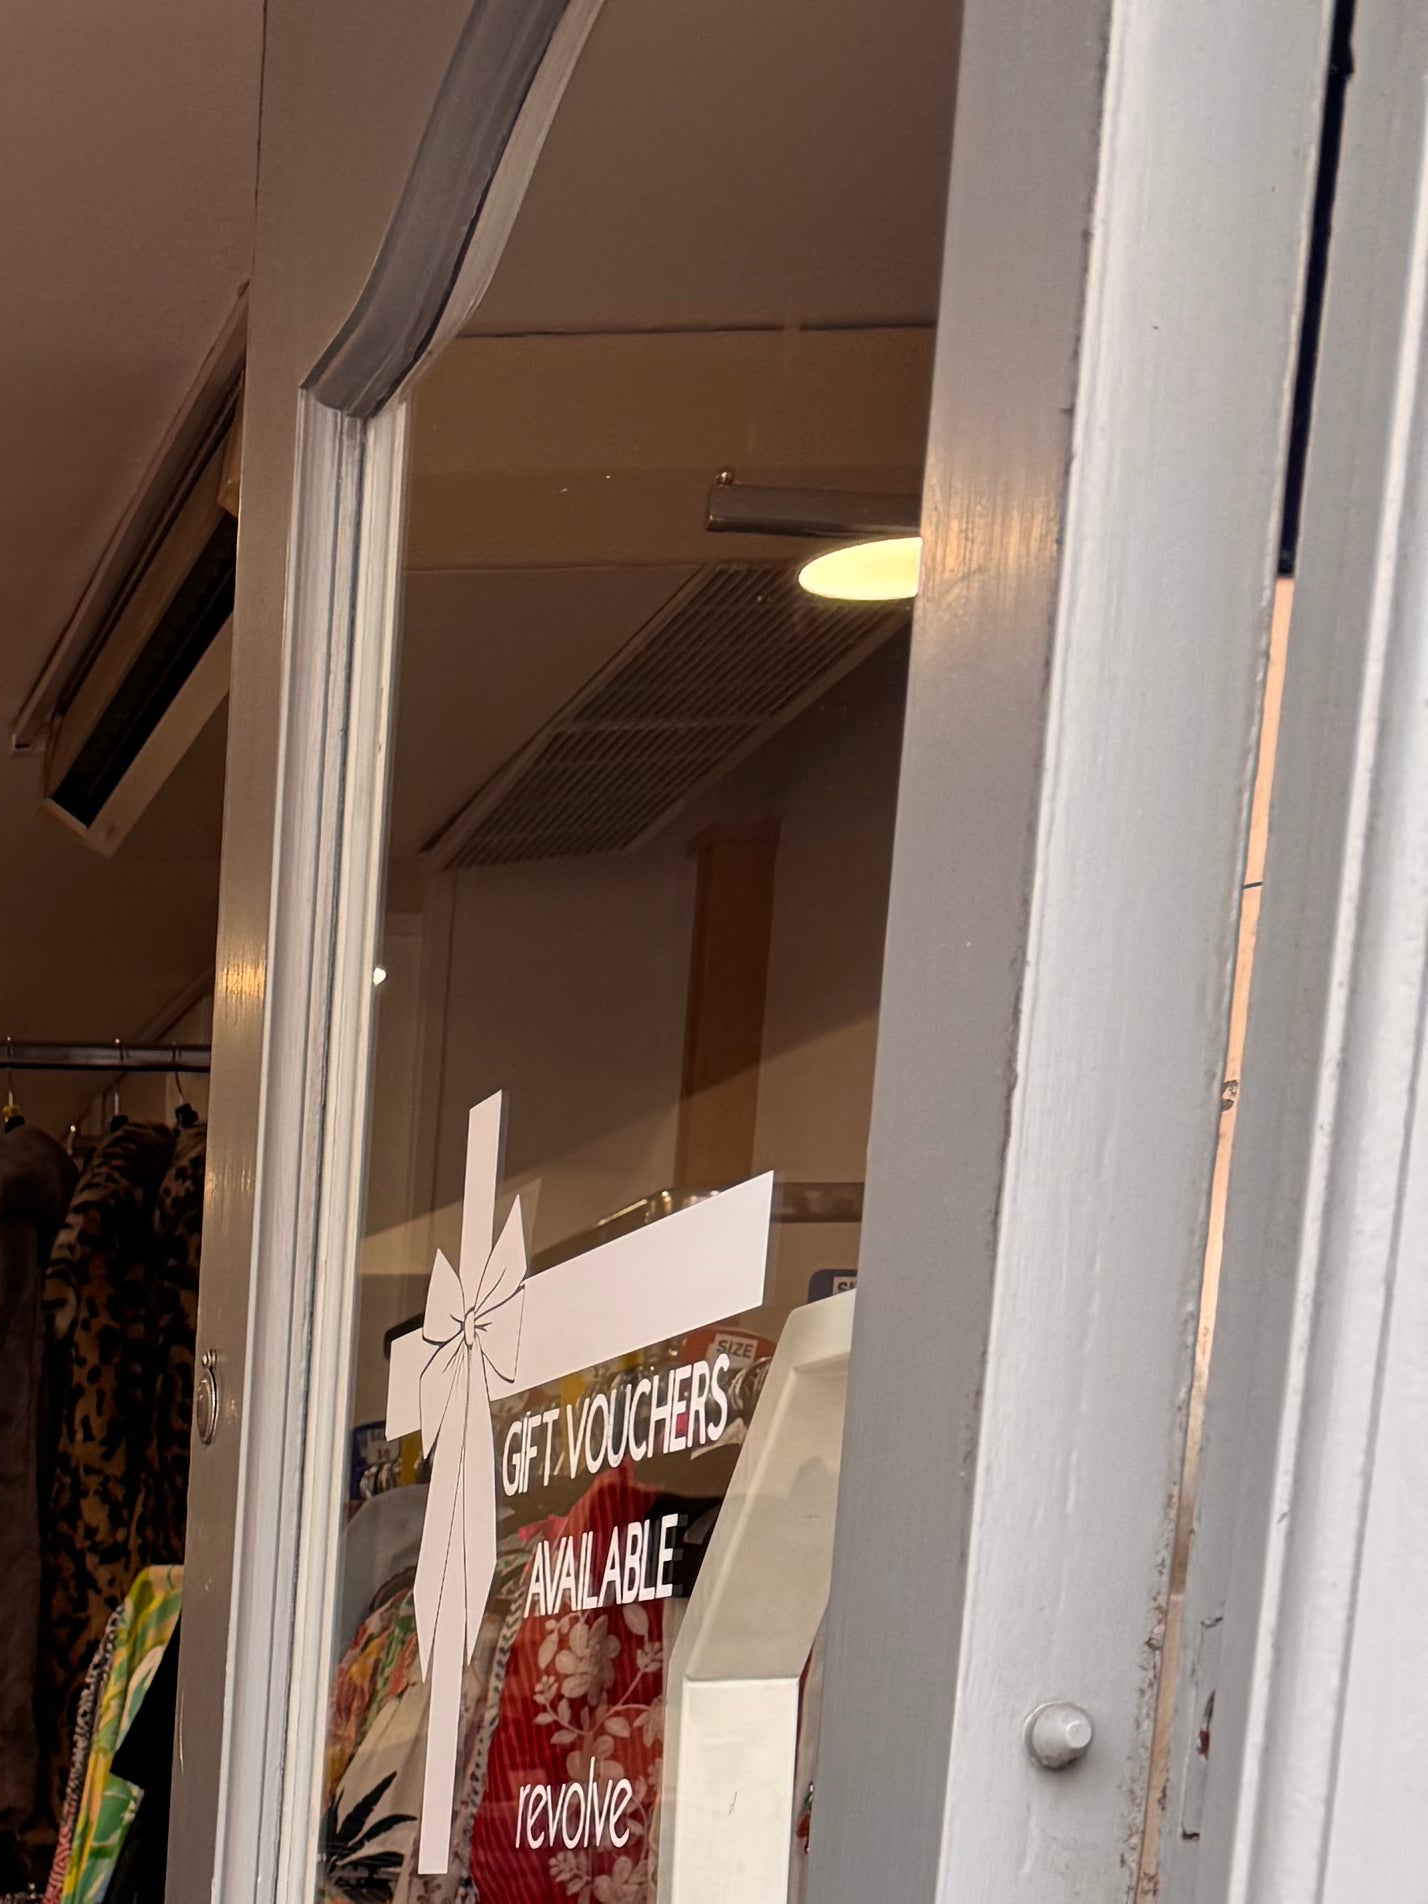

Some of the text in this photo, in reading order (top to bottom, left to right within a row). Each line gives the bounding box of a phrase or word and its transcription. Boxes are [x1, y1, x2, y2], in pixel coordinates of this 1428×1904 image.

[717, 1339, 754, 1359] SIZE
[502, 1353, 731, 1497] GIFT VOUCHERS
[523, 1513, 679, 1619] AVAILABLE
[515, 1756, 633, 1850] revolve
